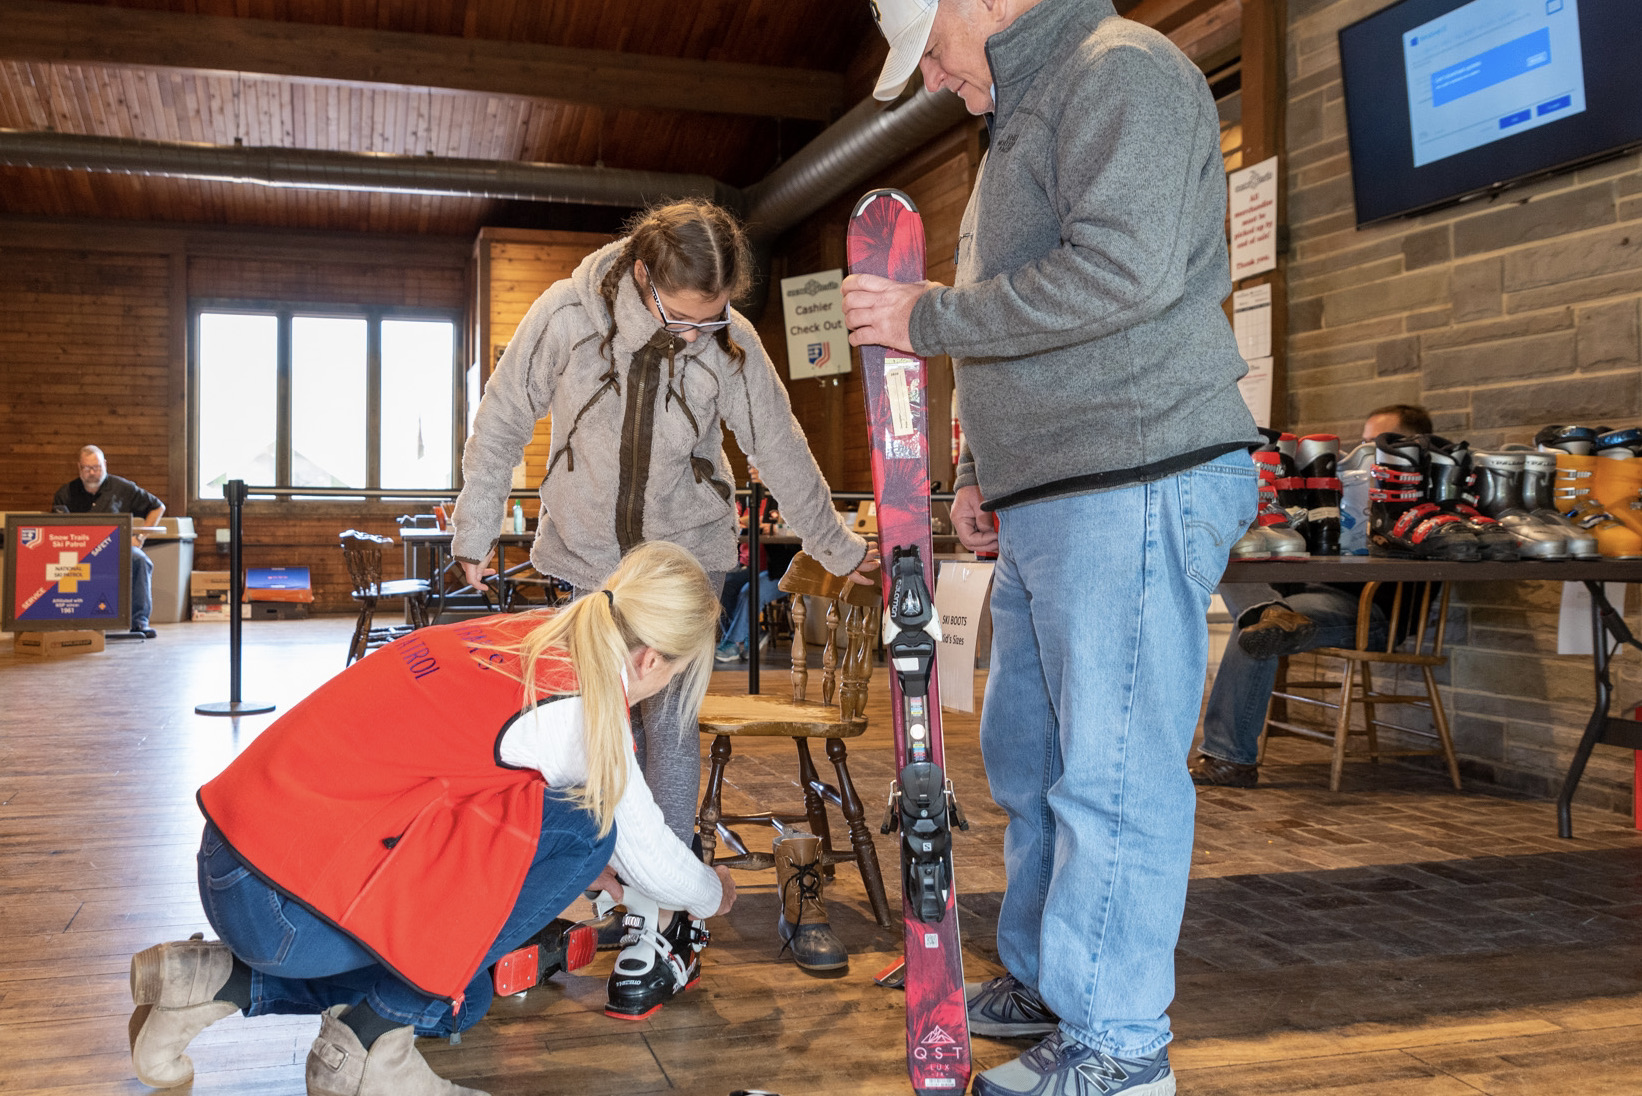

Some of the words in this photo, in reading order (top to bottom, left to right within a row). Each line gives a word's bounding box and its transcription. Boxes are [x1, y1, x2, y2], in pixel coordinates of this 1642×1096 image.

[795, 302, 833, 316] Cashier
[790, 324, 820, 336] Check
[823, 320, 843, 331] Out
[90, 536, 112, 557] SAFETY
[21, 587, 47, 610] SERVICE
[942, 614, 950, 624] SKI
[950, 615, 967, 626] BOOTS
[952, 634, 965, 645] Sizes
[914, 1046, 963, 1060] QST
[930, 1063, 950, 1071] LUX
